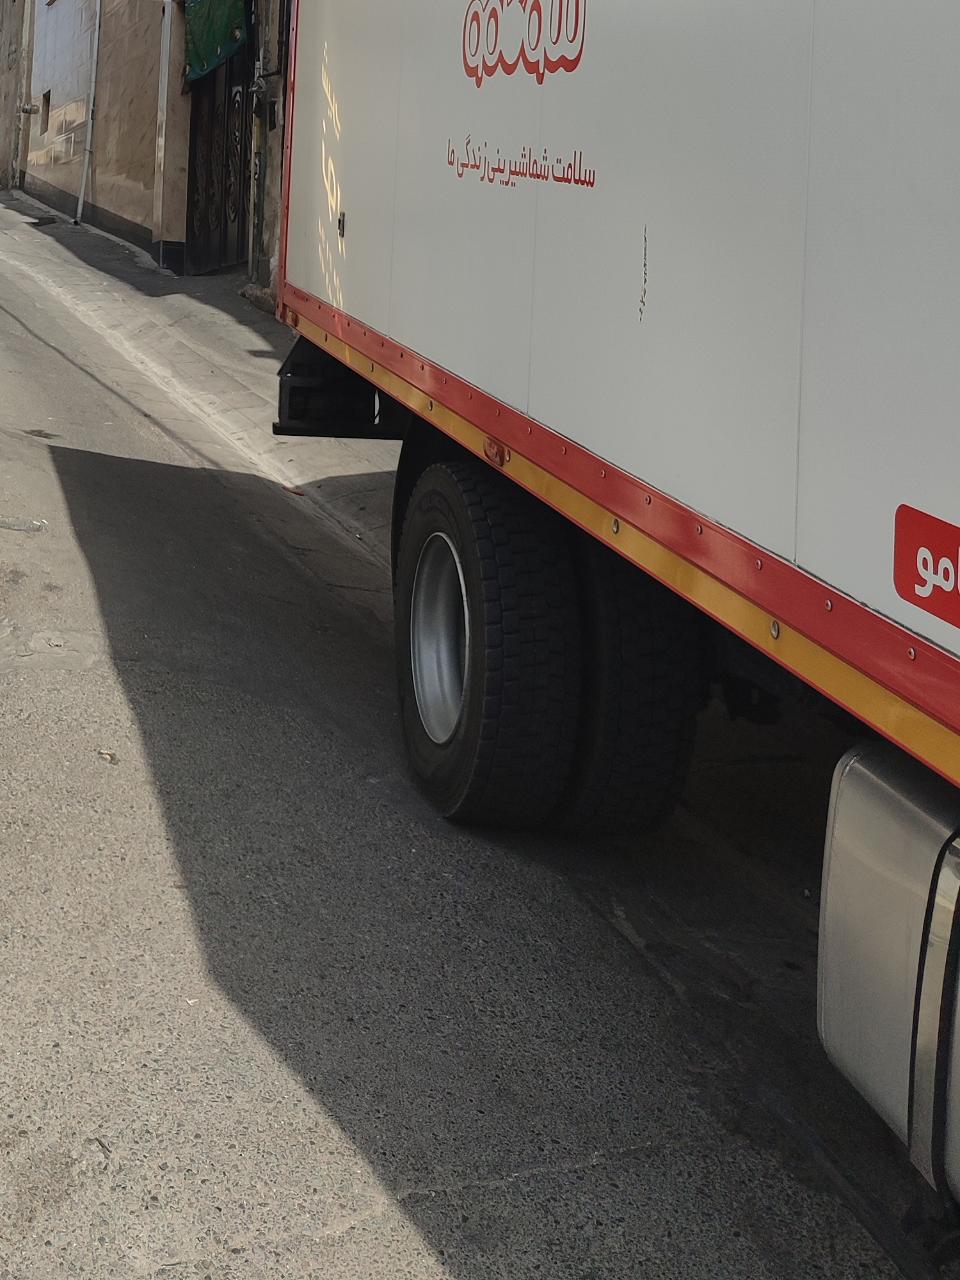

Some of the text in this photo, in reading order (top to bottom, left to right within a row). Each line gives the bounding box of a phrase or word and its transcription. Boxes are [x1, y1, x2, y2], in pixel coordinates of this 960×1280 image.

[447, 133, 596, 188] سلامت شما شیرینی زندگی ما
